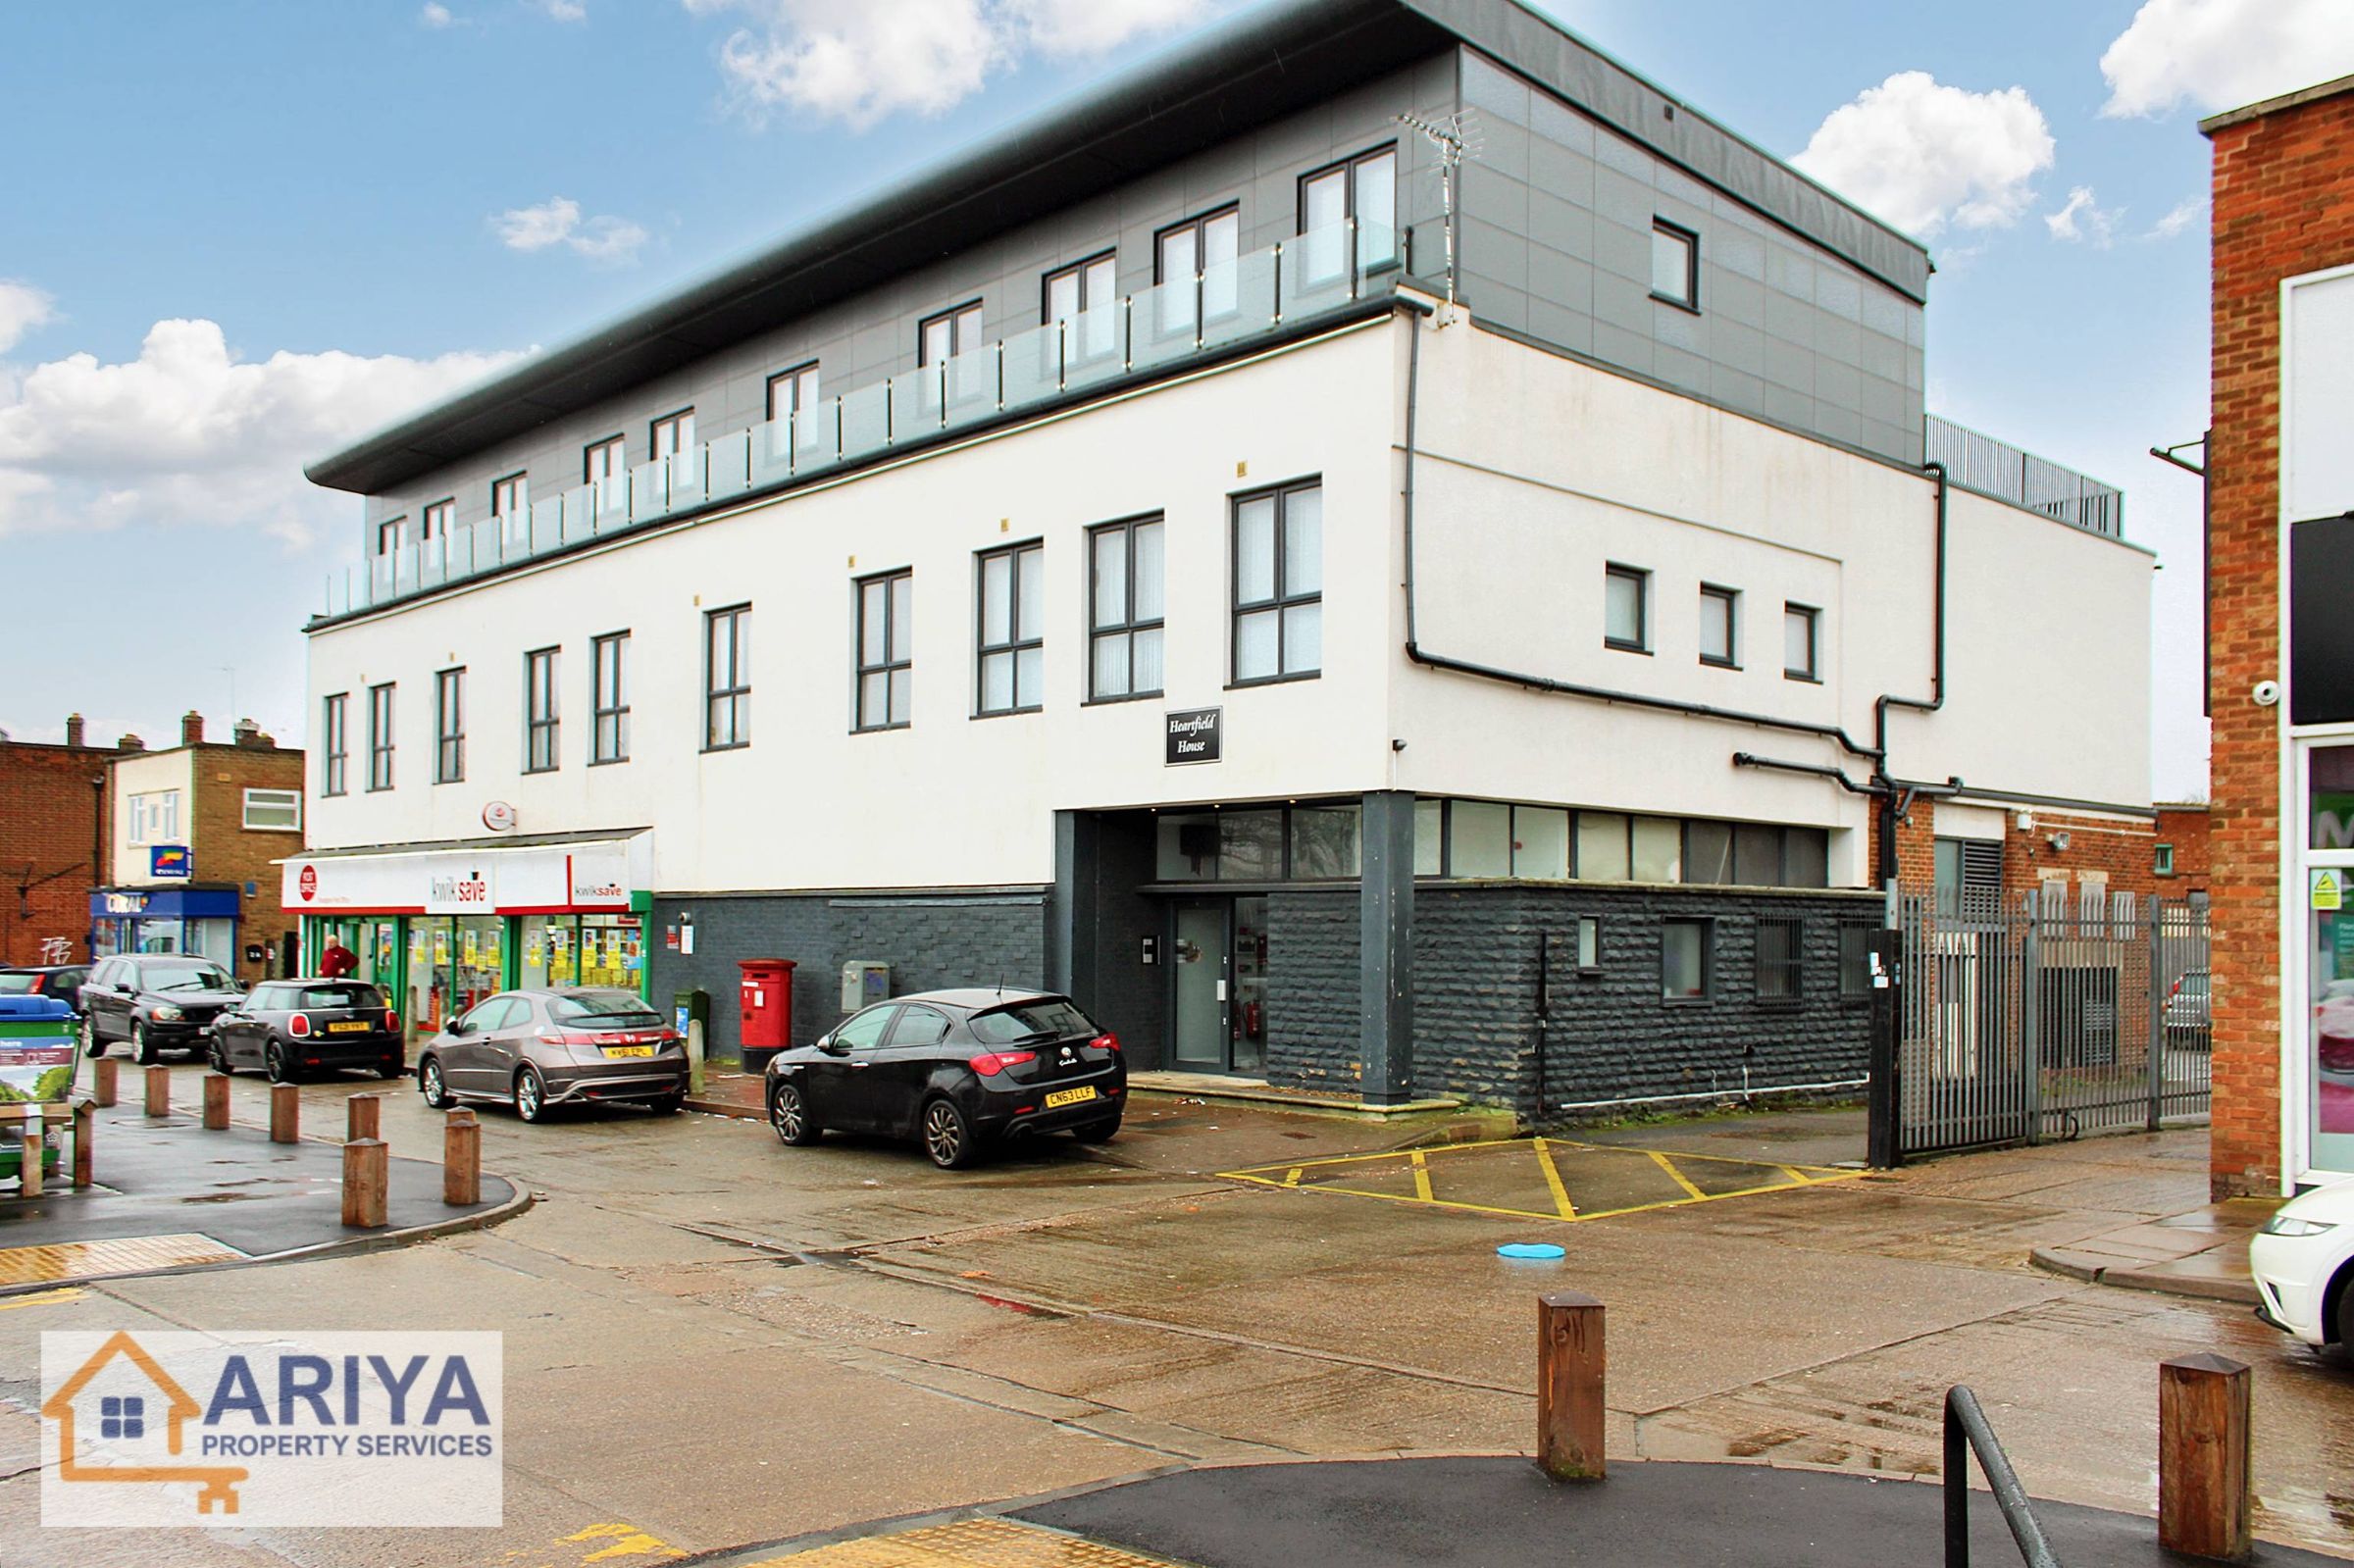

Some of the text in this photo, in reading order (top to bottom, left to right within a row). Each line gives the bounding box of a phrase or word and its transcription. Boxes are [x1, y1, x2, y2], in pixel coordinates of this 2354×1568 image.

[1169, 713, 1216, 736] Heartfield
[1177, 740, 1205, 753] House
[1049, 1087, 1092, 1105] CN63 LLF
